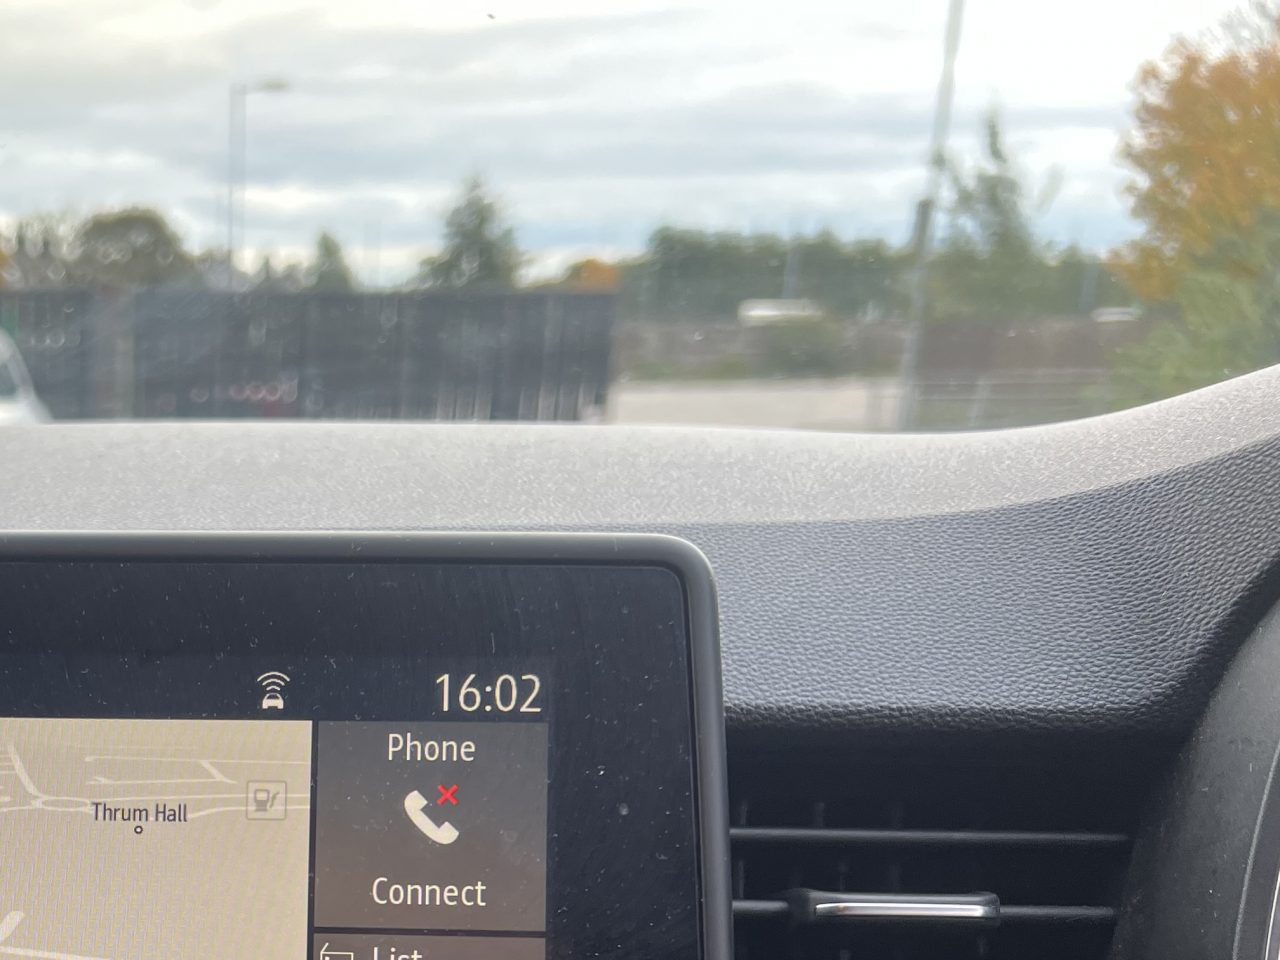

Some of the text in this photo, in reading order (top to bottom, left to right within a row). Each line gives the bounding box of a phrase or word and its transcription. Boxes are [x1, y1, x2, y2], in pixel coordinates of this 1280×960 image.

[435, 673, 542, 713] 16:02
[387, 732, 476, 762] Phone
[91, 802, 188, 823] Thrum Hall
[371, 877, 487, 906] Connect
